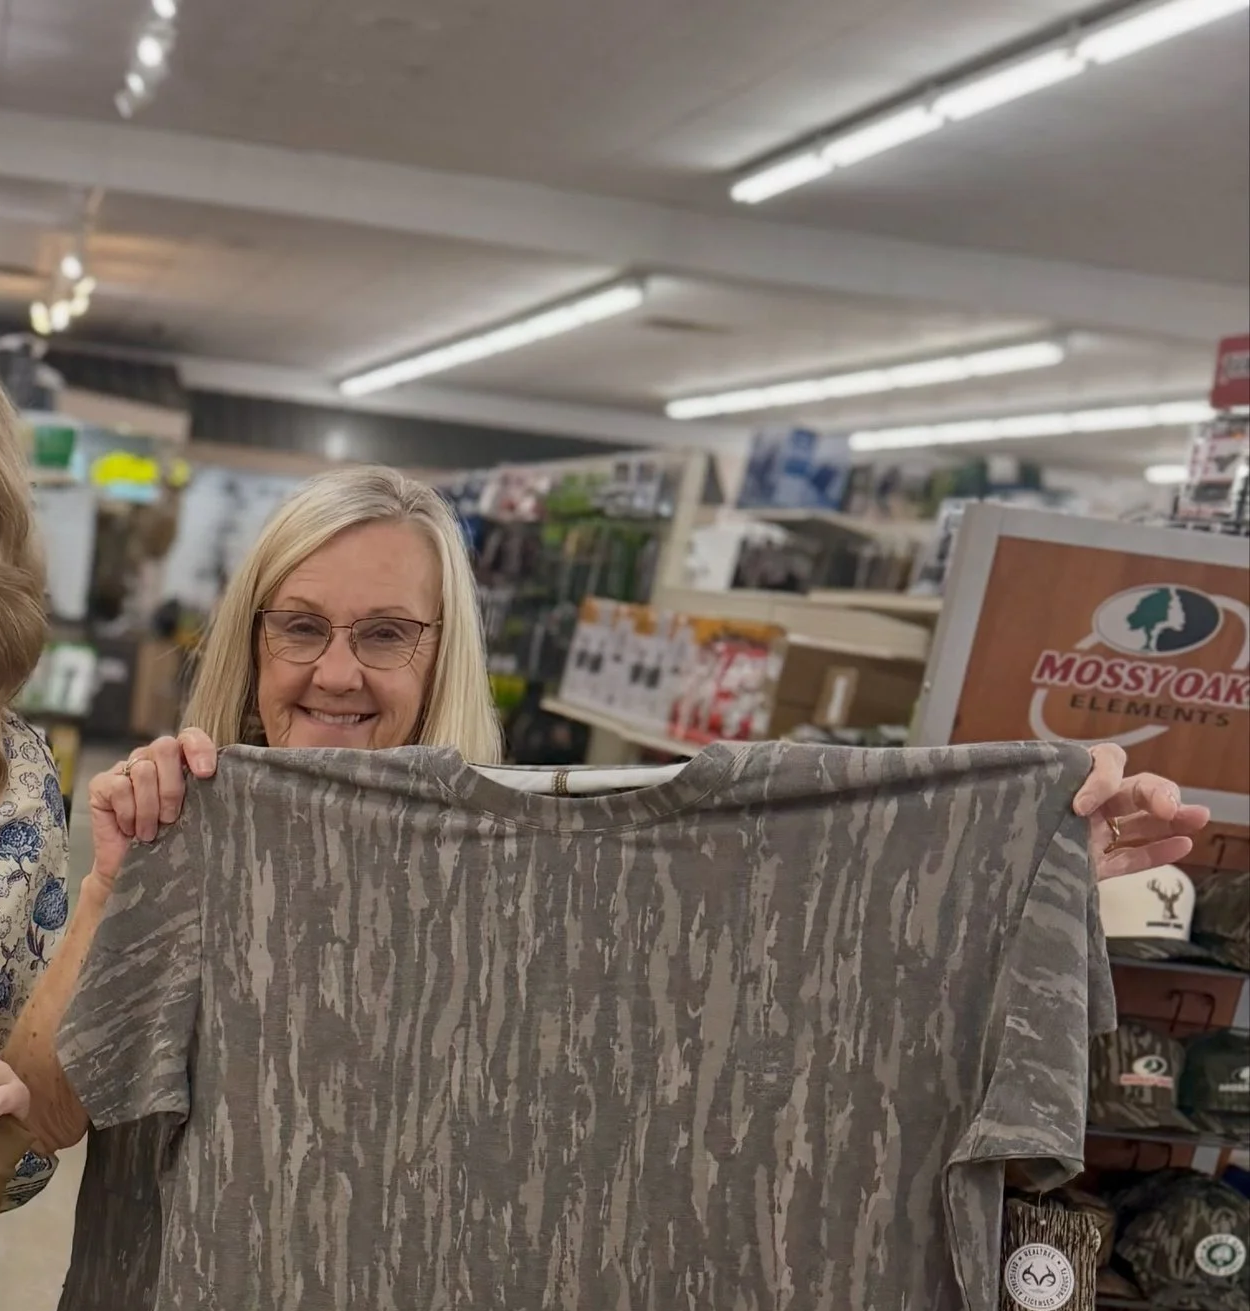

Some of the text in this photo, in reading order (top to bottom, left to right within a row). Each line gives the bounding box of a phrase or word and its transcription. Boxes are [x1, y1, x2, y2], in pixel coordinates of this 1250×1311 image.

[1033, 651, 1250, 707] MOSSY OAK
[1070, 693, 1230, 727] ELEMENTS
[1023, 1248, 1056, 1260] REALTREE
